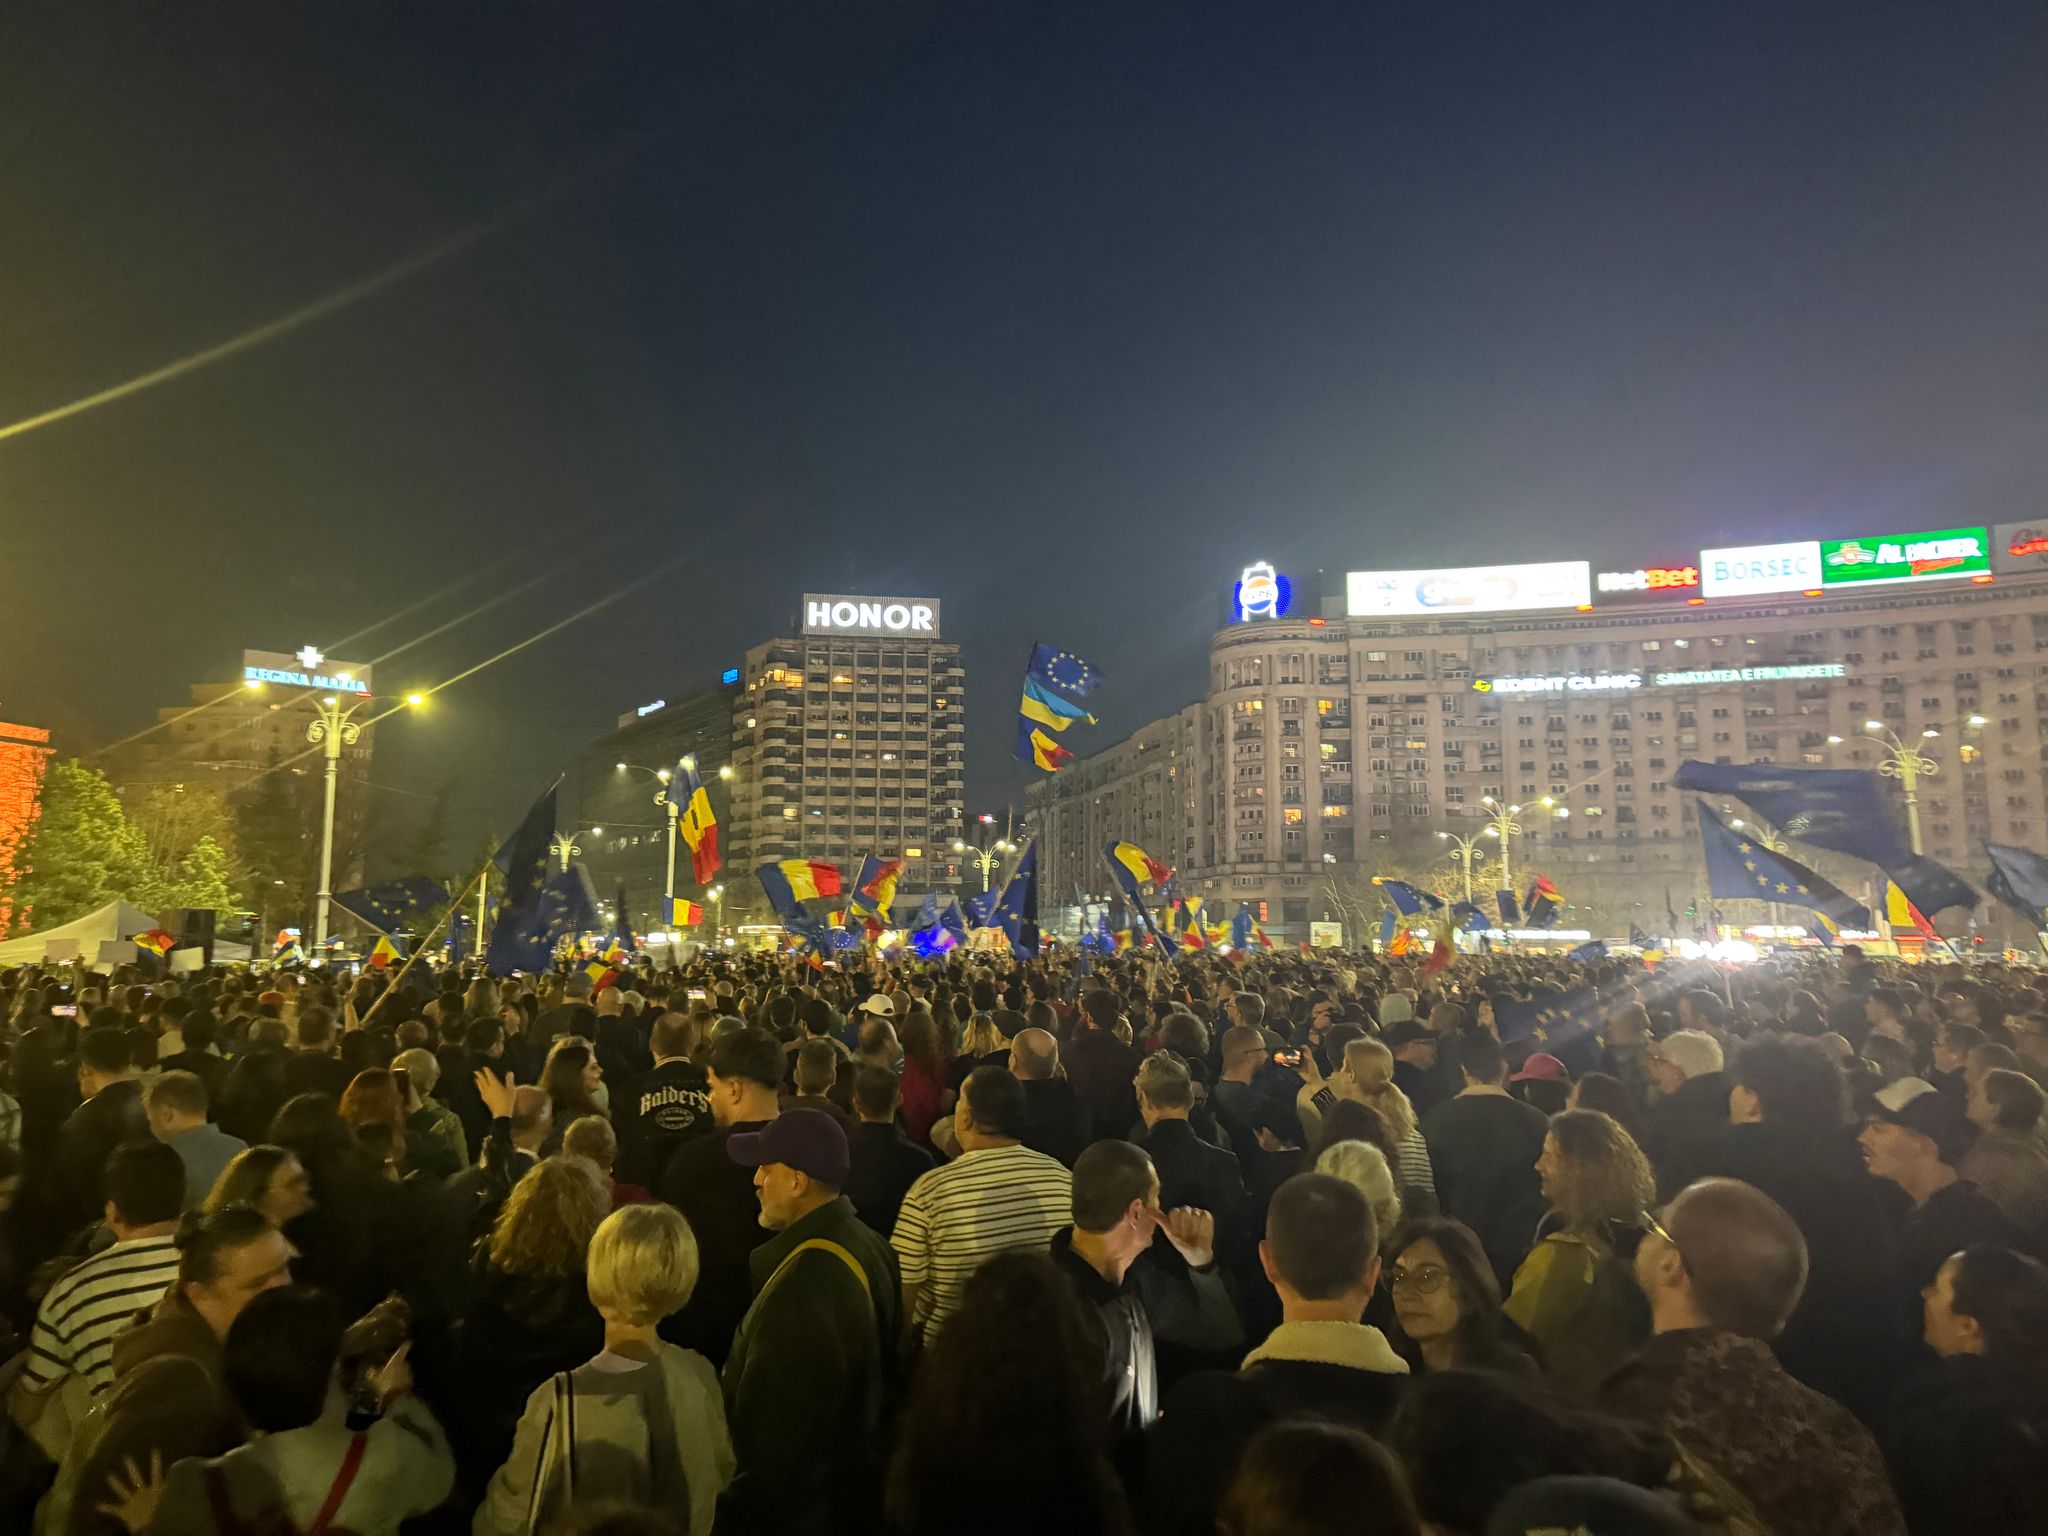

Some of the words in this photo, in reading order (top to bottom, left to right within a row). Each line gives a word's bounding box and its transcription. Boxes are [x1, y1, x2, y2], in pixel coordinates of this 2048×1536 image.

[1714, 557, 1809, 581] BORSEC
[808, 601, 933, 630] HONOR
[244, 667, 310, 686] REGINA
